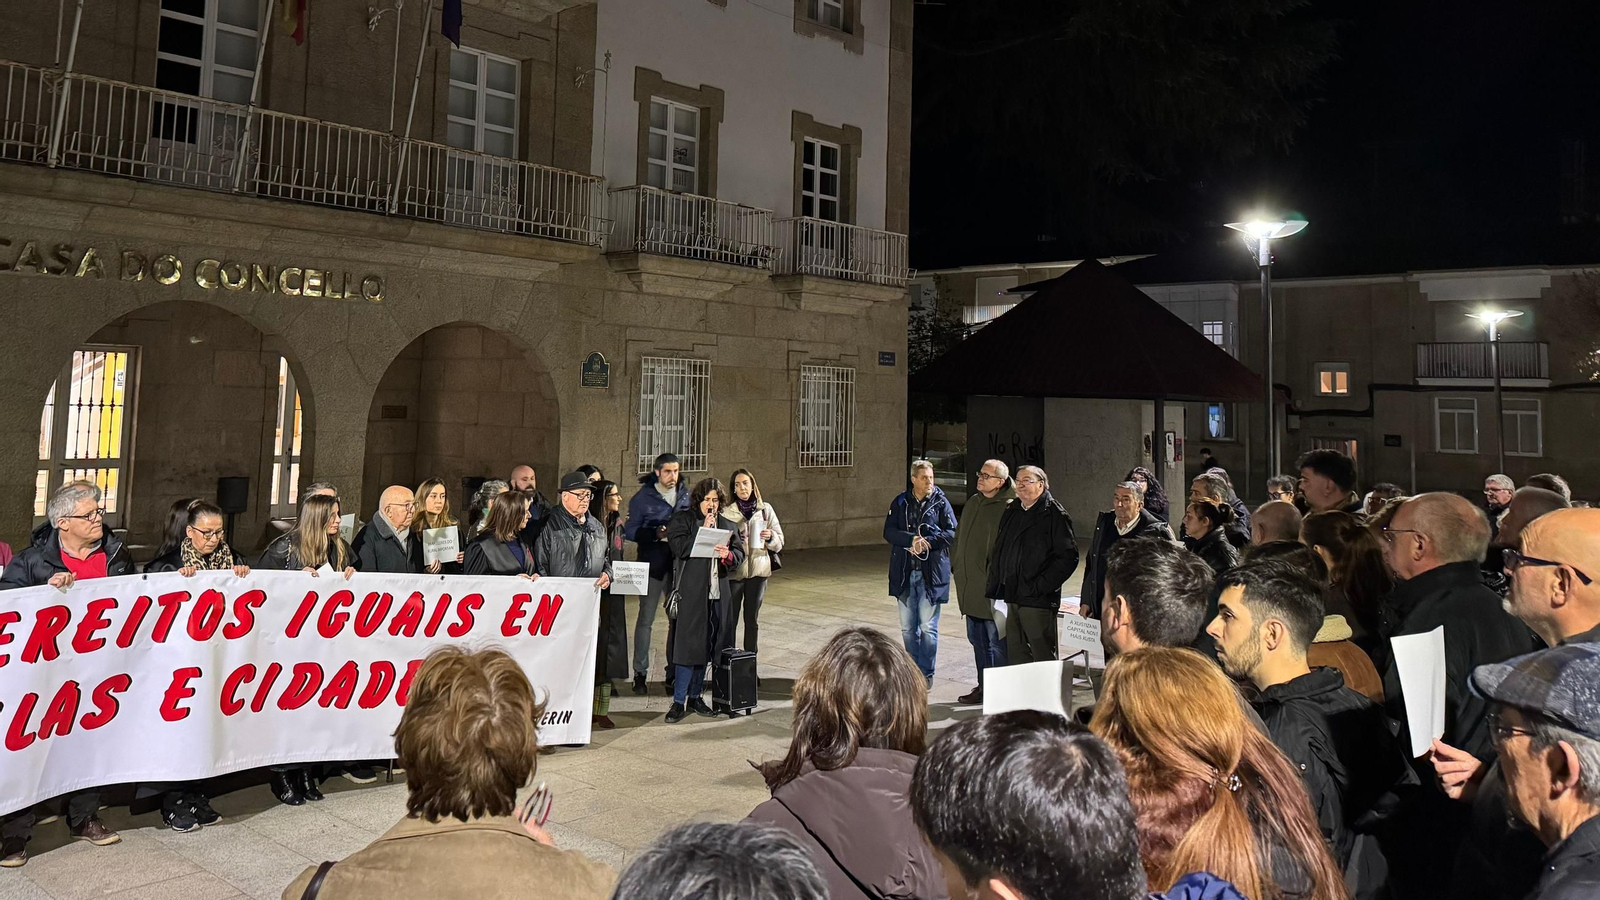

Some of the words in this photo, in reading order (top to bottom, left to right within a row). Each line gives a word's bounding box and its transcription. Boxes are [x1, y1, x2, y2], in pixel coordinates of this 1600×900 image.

[120, 249, 182, 286] DO
[195, 259, 386, 302] CONCELLO
[988, 432, 1006, 456] No
[285, 589, 486, 641] IGUAIS
[500, 593, 565, 639] EN
[1066, 626, 1086, 635] CAPITAL
[0, 673, 133, 752] LAS
[160, 666, 204, 722] E
[534, 710, 573, 726] ERIN
